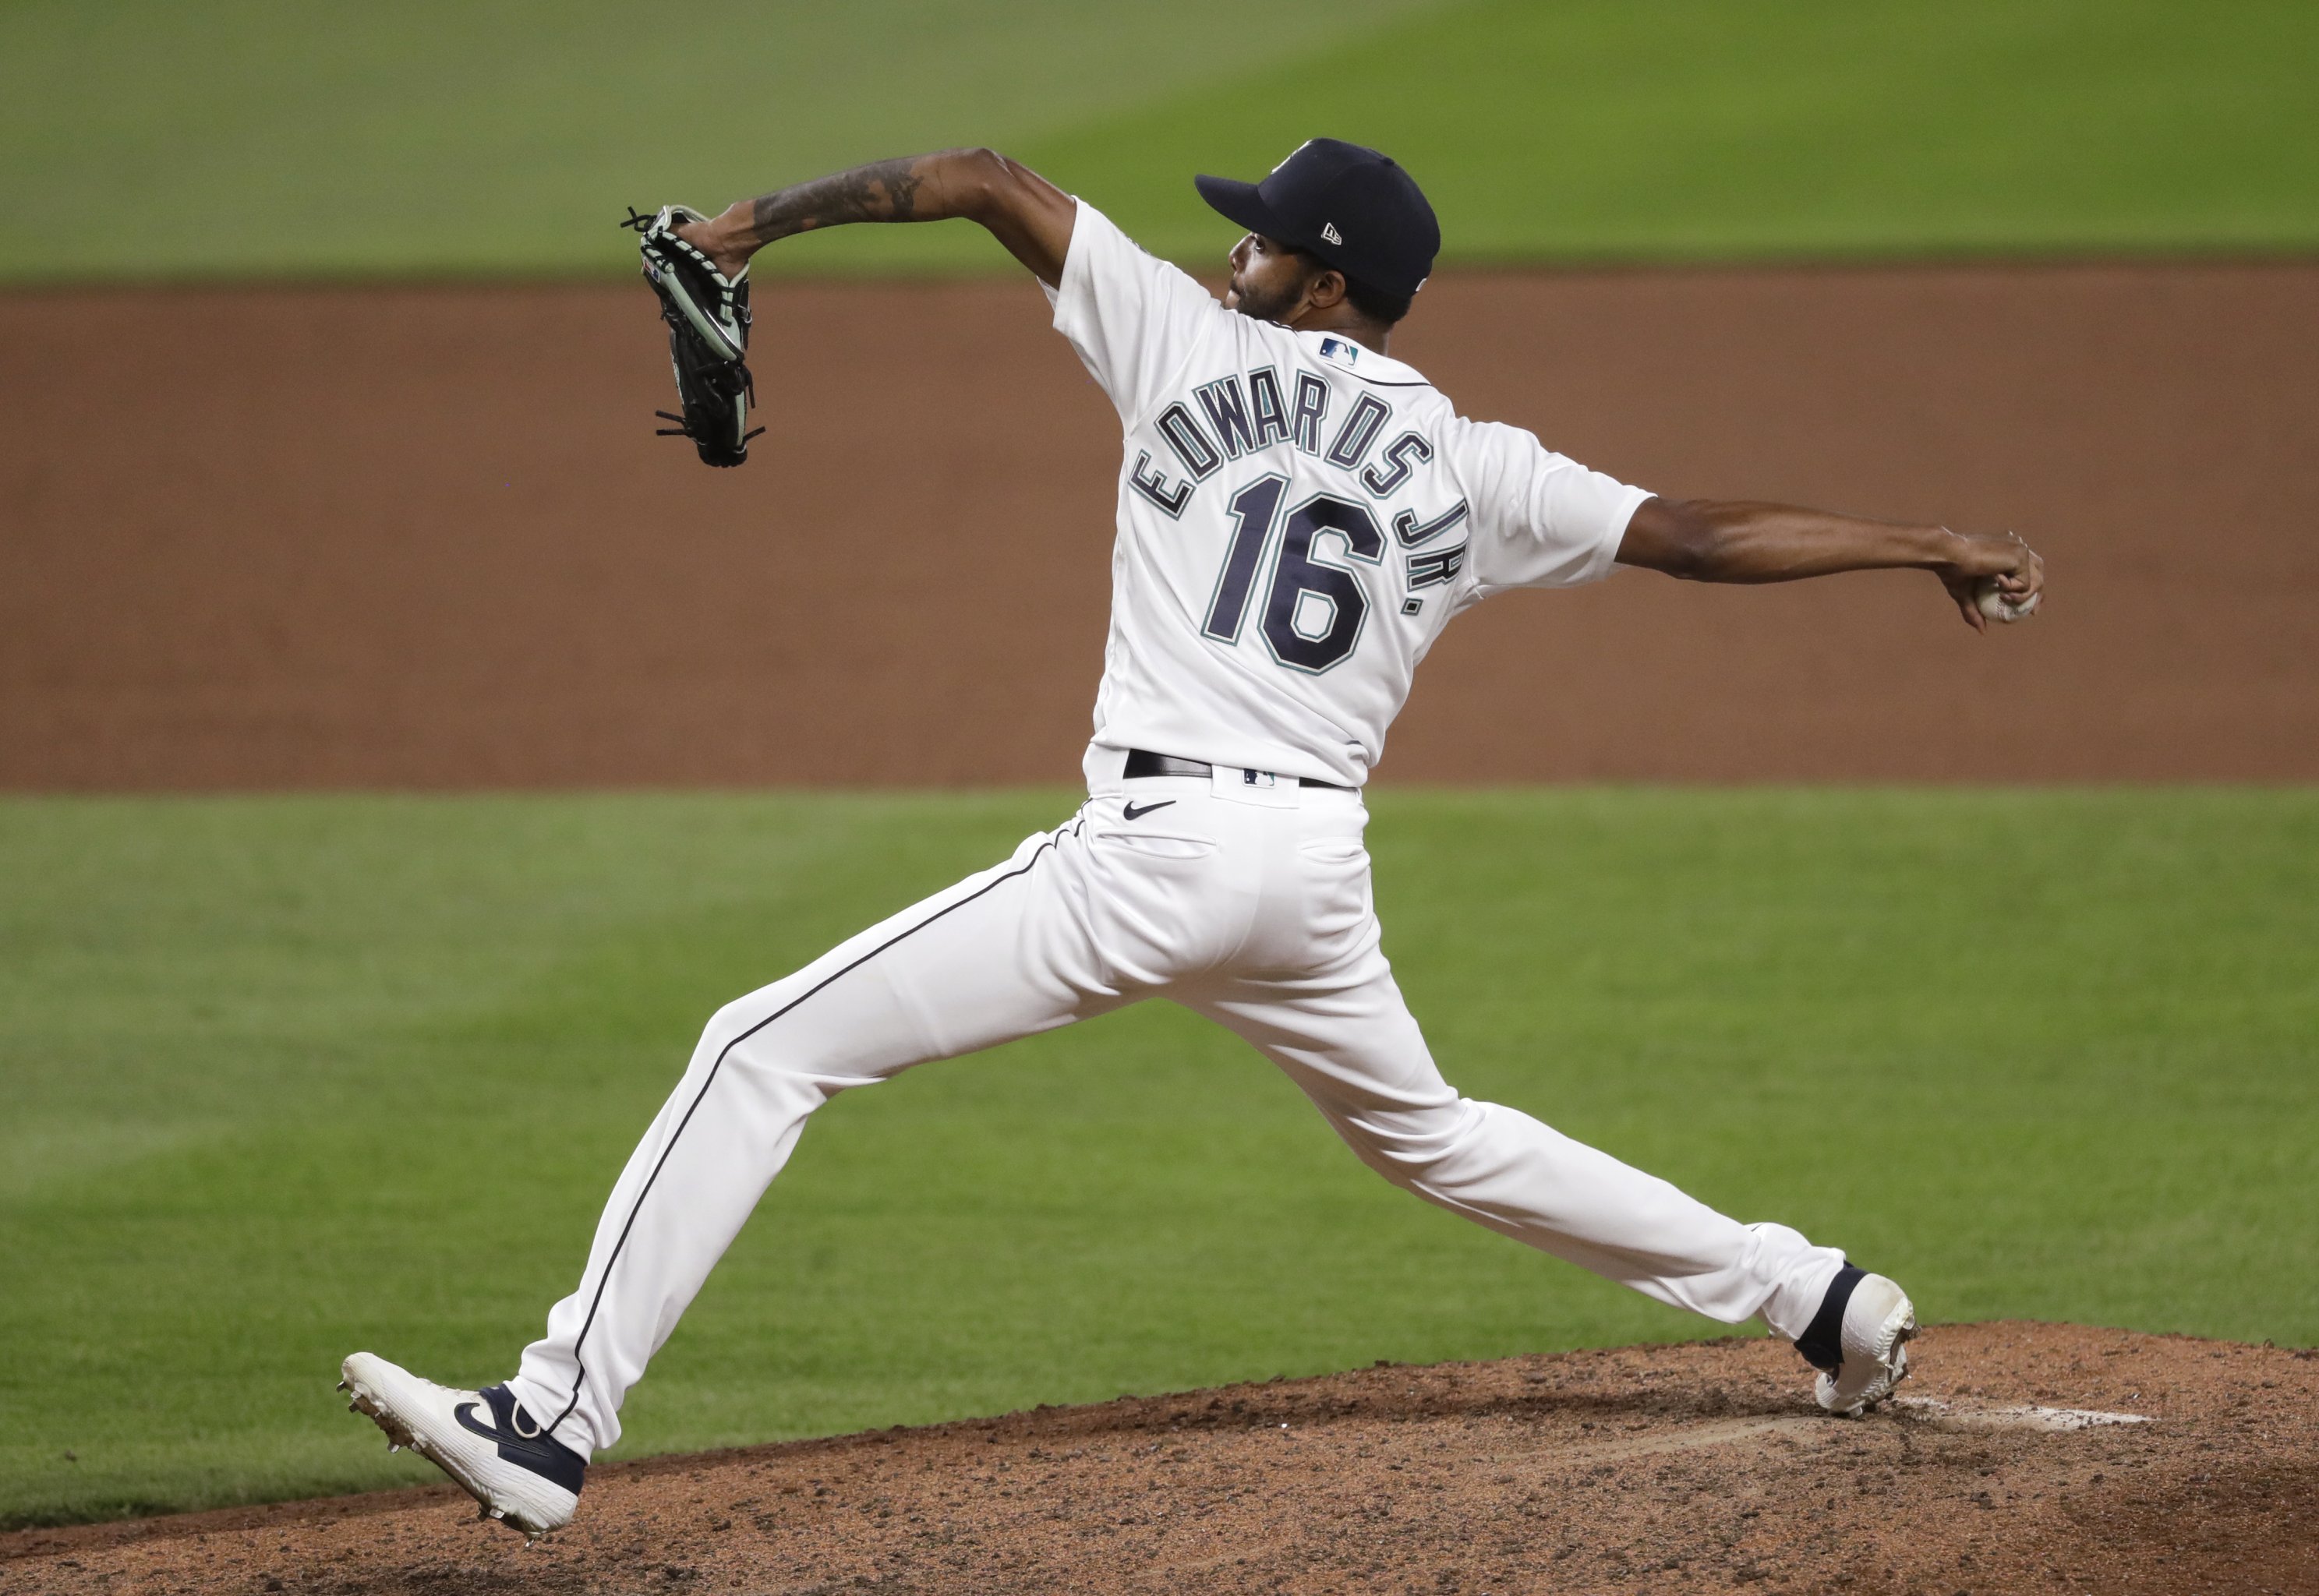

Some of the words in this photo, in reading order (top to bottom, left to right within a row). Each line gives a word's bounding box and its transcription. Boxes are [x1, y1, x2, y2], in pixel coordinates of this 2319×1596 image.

[1128, 365, 1433, 521] EDWARDS
[1391, 499, 1469, 616] JR.
[1201, 471, 1388, 676] 16
